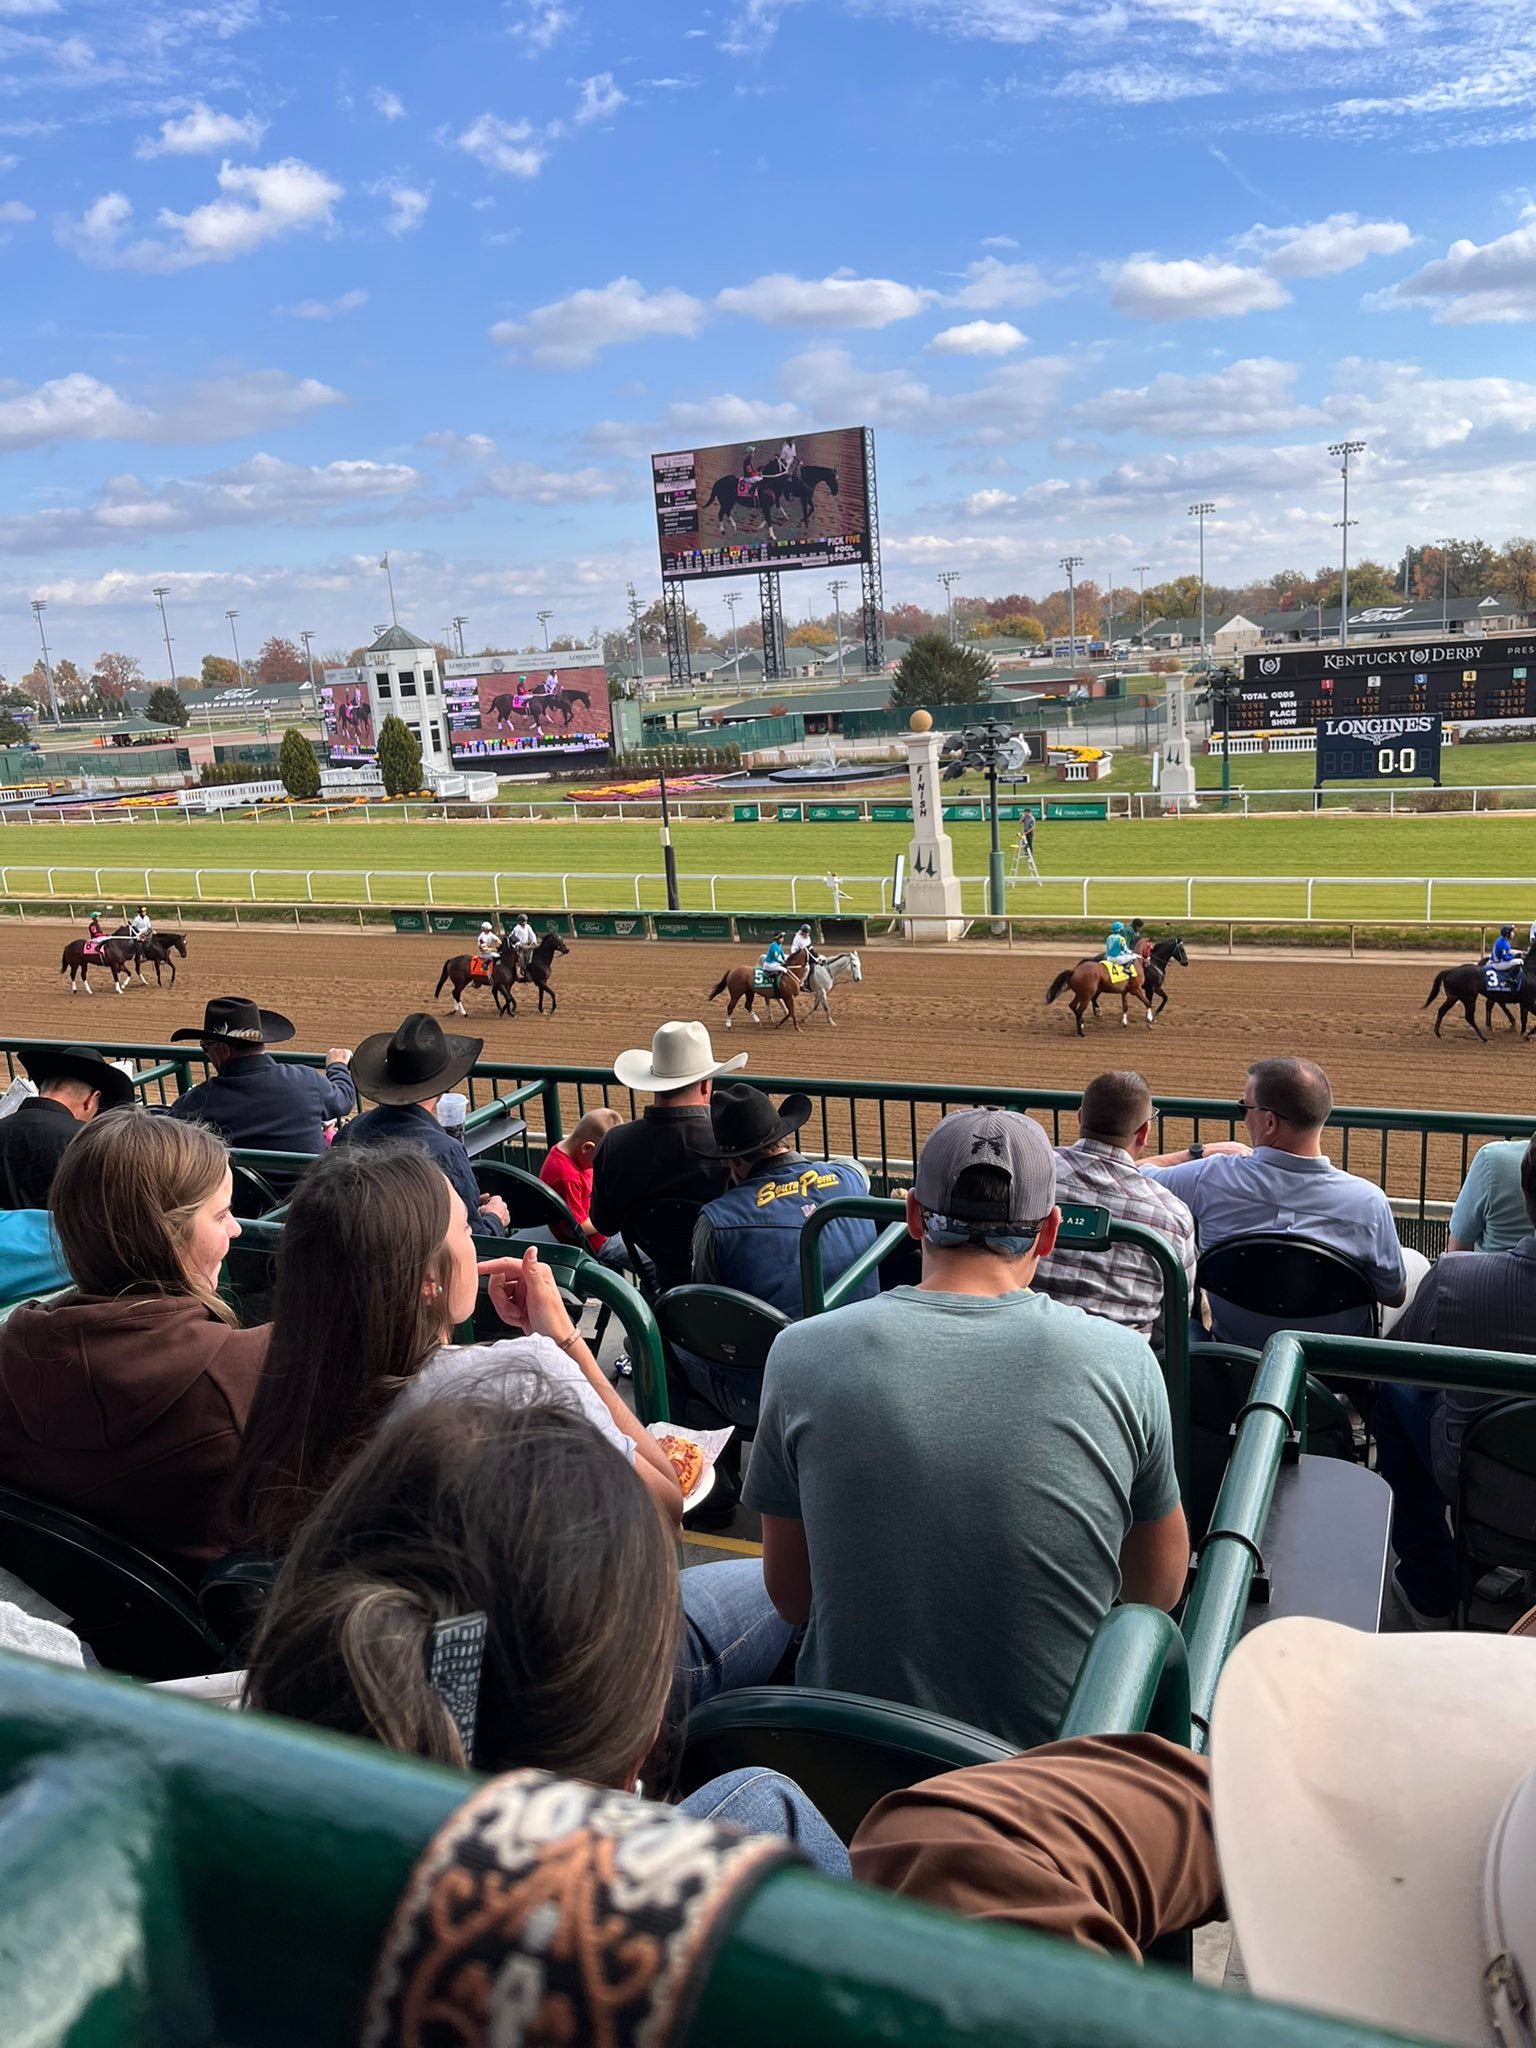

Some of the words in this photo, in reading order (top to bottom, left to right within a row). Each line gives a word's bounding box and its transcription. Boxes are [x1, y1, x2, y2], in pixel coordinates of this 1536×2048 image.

[828, 537, 844, 546] PICK
[845, 534, 861, 544] FIVE
[835, 545, 855, 553] POOL
[1348, 607, 1414, 623] Ford
[1323, 651, 1408, 670] KENTUCKY
[1432, 646, 1484, 661] DERBY
[1241, 692, 1269, 701] TOTAL
[1271, 691, 1295, 699] ODDS
[1269, 710, 1297, 718] PLACE
[1326, 717, 1432, 735] LONGINES
[916, 765, 927, 817] FINISH
[616, 921, 633, 931] SAP
[473, 959, 478, 970] 7
[1112, 965, 1118, 976] 4
[754, 969, 763, 984] 5
[1486, 970, 1498, 987] 3
